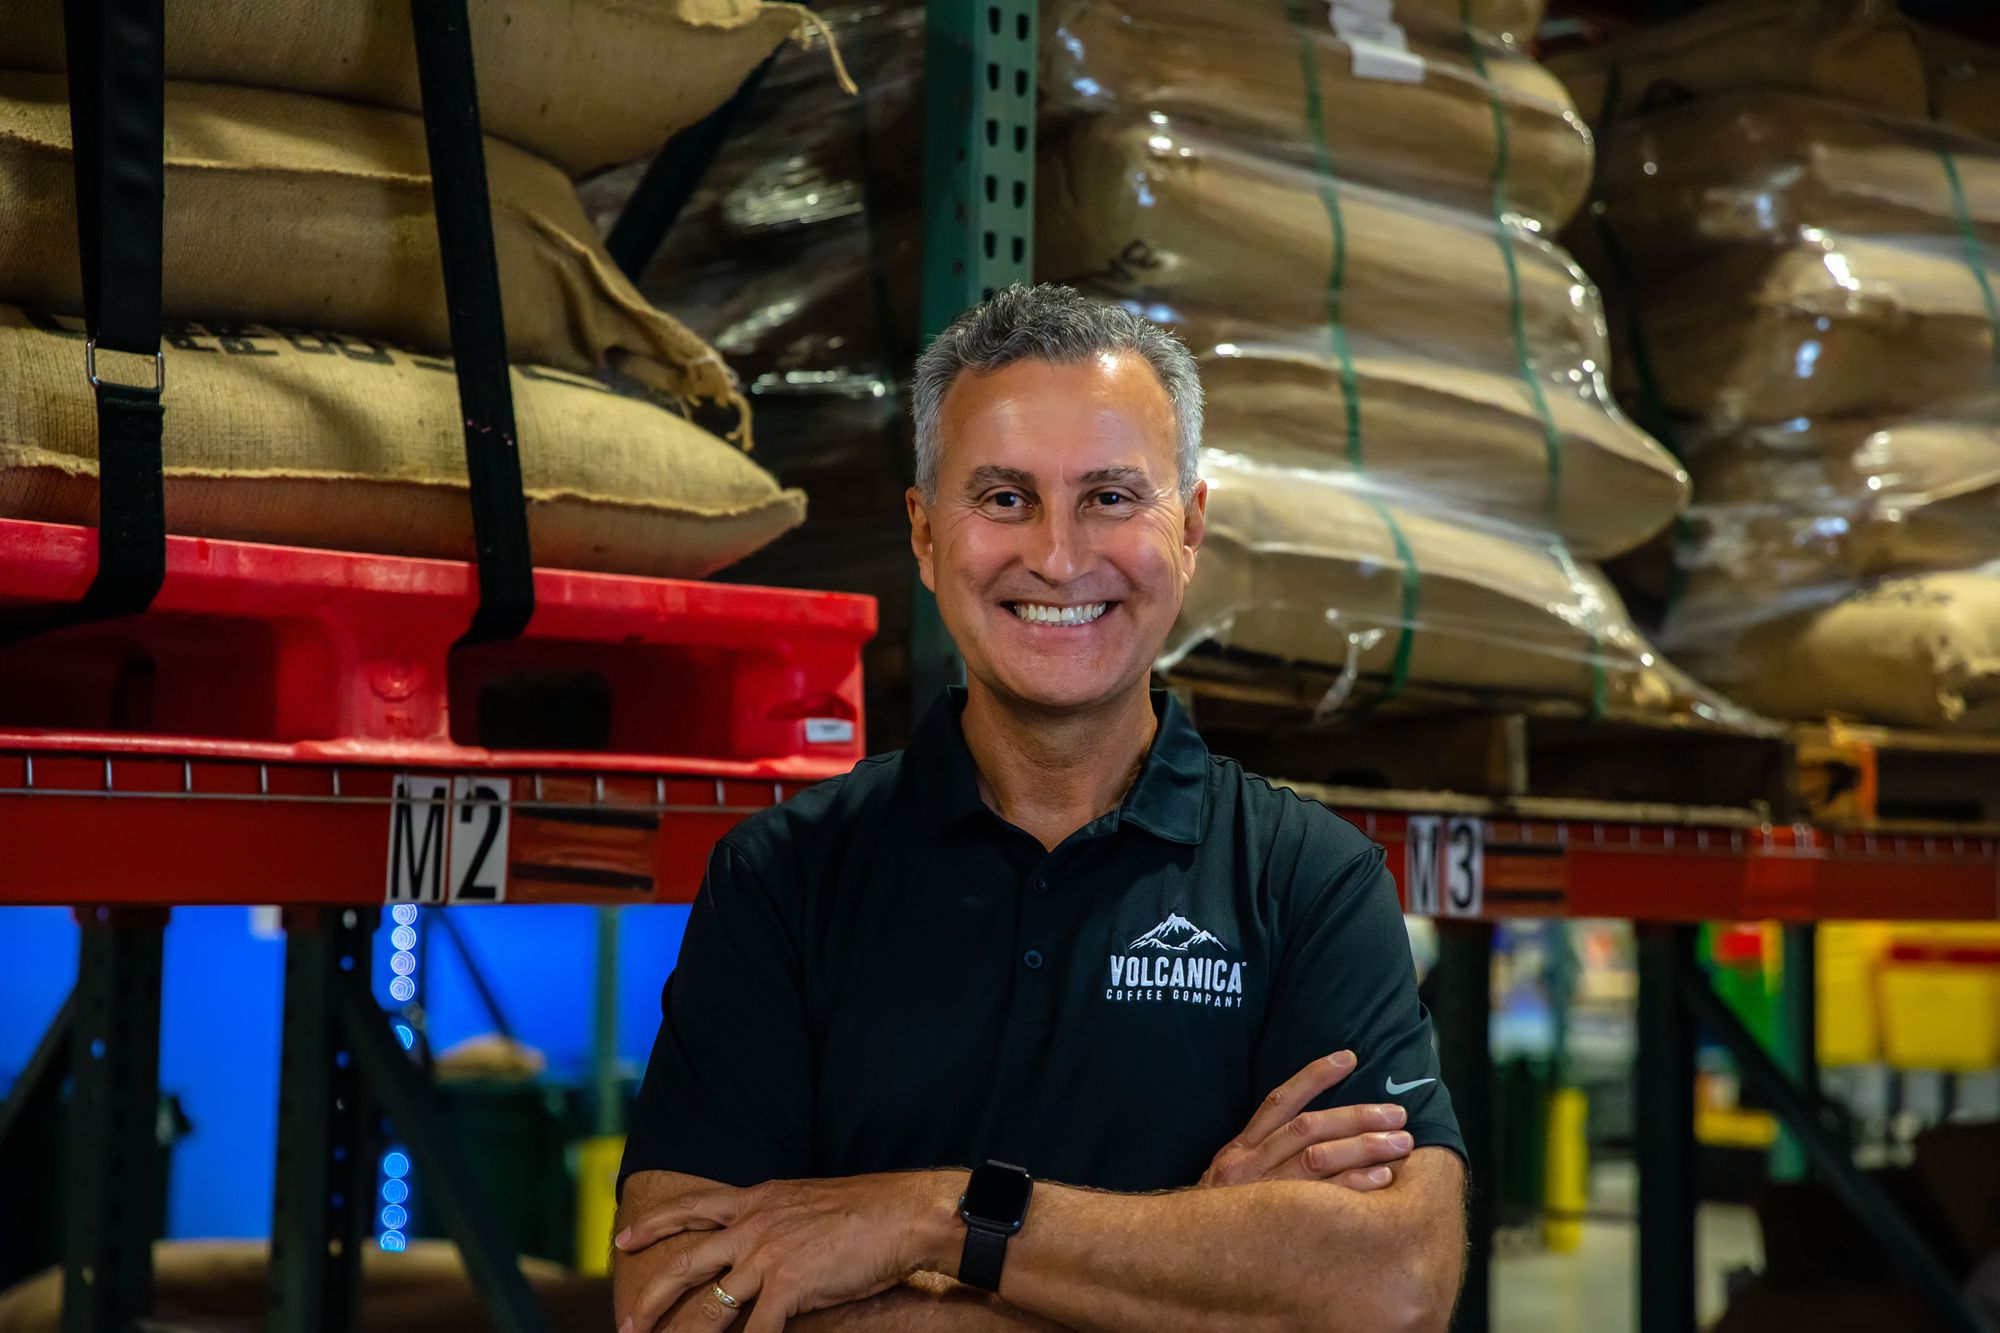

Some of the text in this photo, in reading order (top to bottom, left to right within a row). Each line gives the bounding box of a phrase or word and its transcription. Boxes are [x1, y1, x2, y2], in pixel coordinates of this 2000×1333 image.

[1110, 955, 1242, 994] VOLCANICA
[1106, 989, 1242, 1008] COFFEE COMPANY
